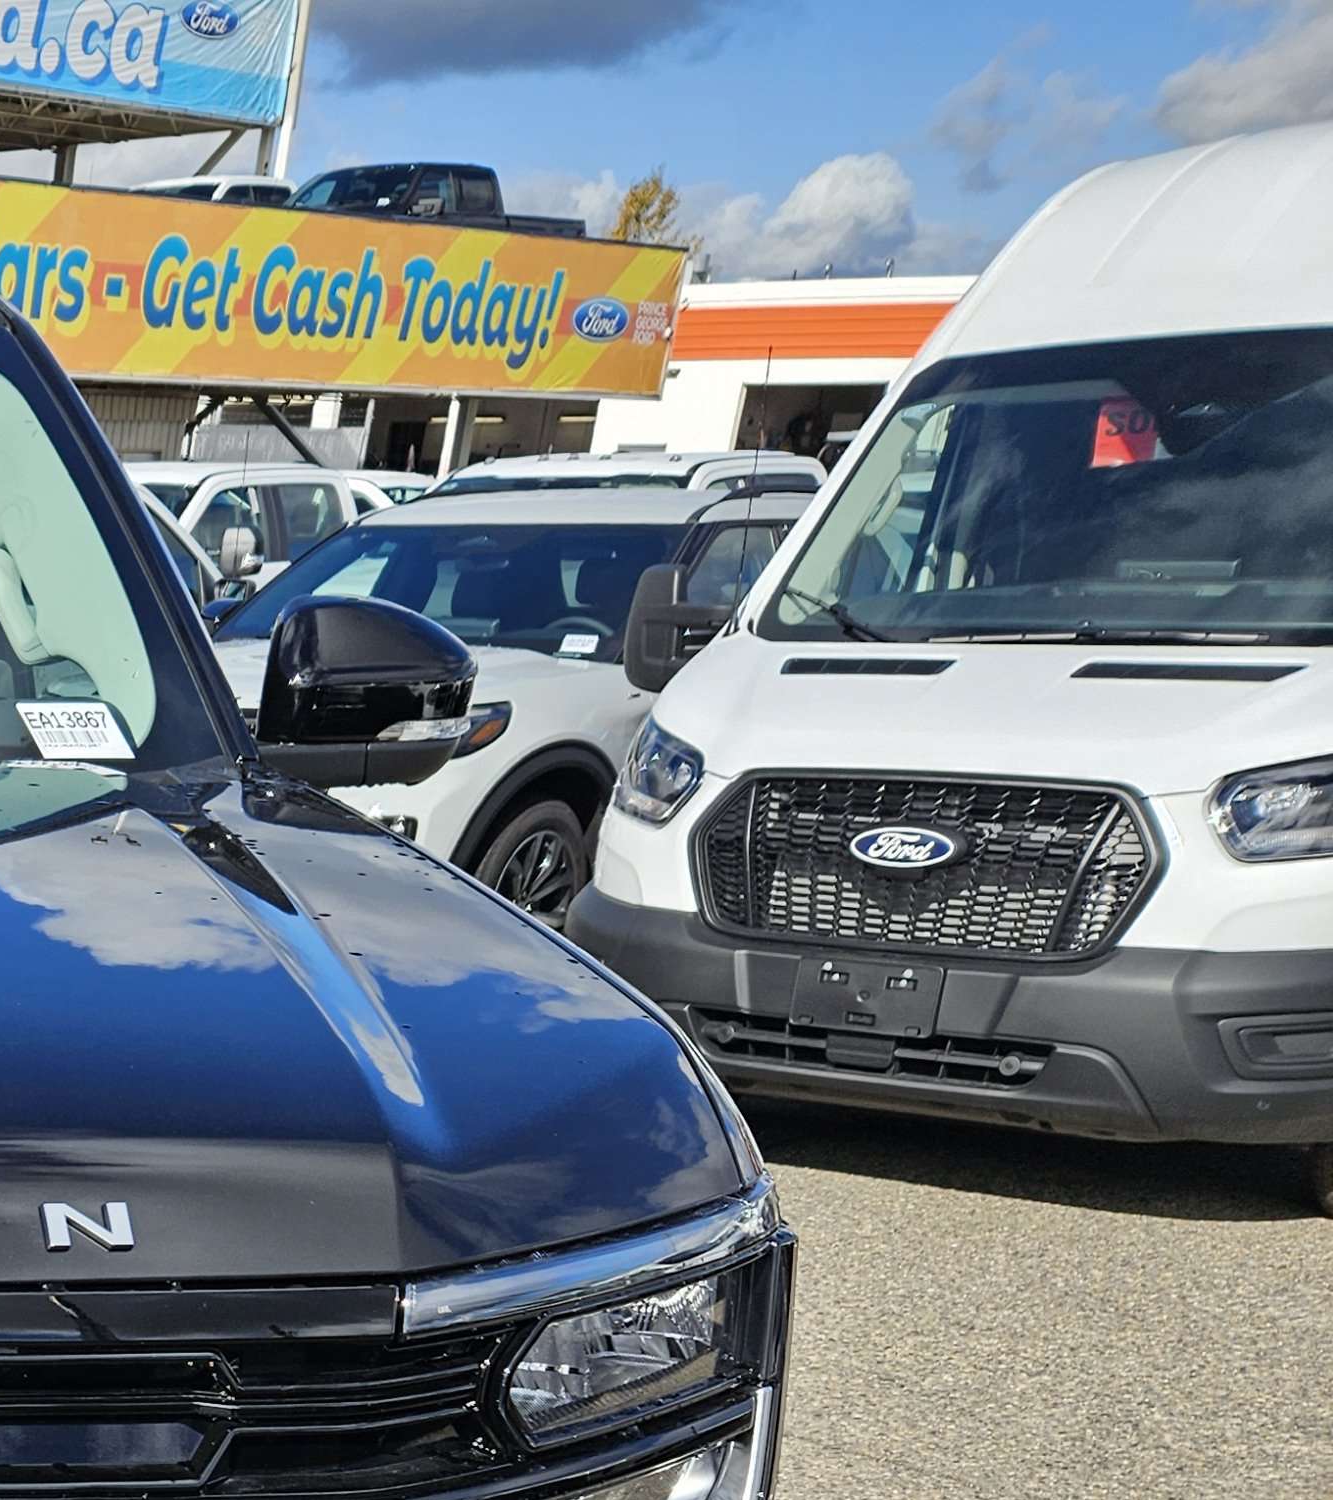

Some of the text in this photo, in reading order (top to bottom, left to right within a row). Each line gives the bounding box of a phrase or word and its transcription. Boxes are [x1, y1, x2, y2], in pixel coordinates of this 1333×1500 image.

[190, 1, 230, 34] Ford
[142, 236, 241, 332] Get
[253, 245, 383, 340] Cash
[399, 256, 566, 370] Today!
[581, 303, 620, 336] Ford
[24, 711, 107, 729] EA13867
[868, 832, 935, 861] Ford
